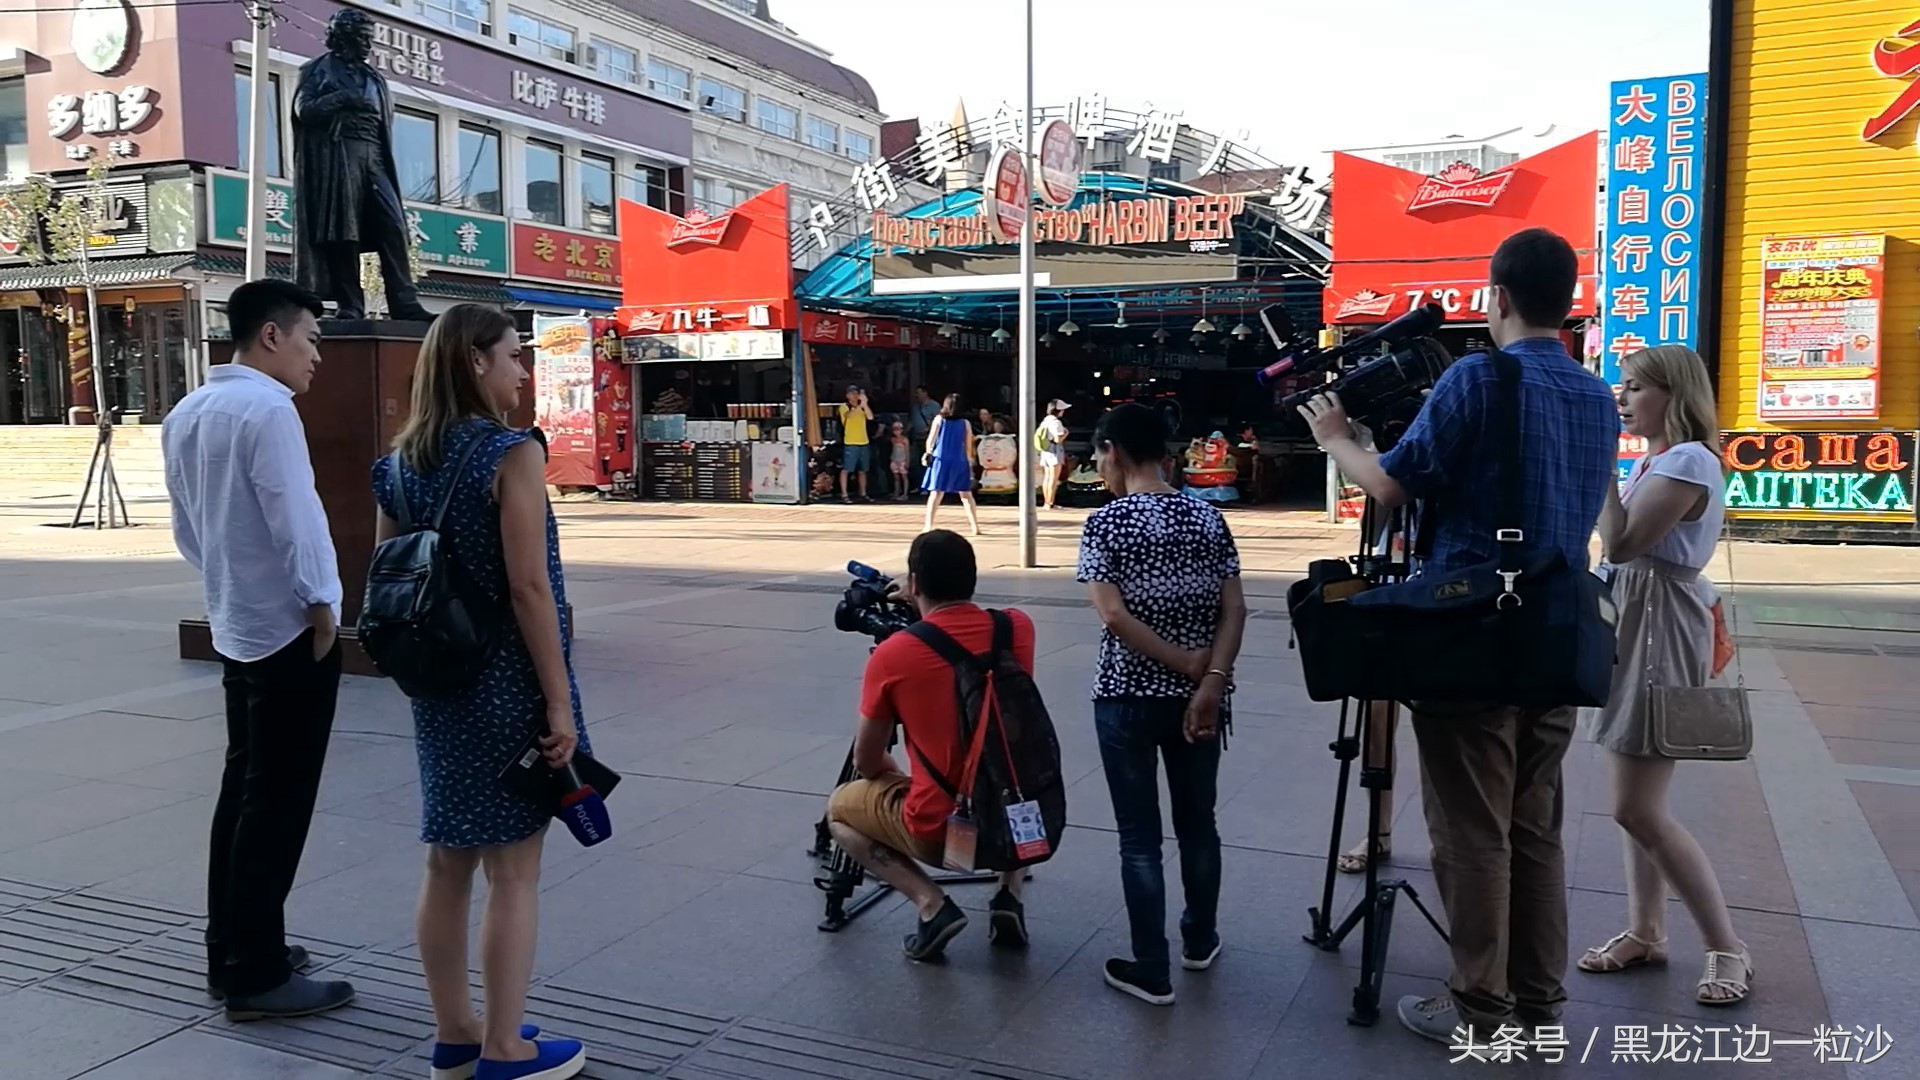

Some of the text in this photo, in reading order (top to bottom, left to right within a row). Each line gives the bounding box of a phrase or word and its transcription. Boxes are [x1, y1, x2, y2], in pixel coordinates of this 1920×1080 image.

[372, 22, 444, 61] ицца
[370, 47, 446, 86] тейк
[1418, 184, 1503, 200] Budweiser
[873, 207, 1081, 258] Представитство
[1659, 81, 1698, 345] ВЕЛОСИП
[533, 232, 615, 269] 老北京
[1771, 268, 1873, 288] 周年庆典
[1723, 471, 1919, 510] АПТЕКА
[574, 804, 599, 840] РОССИЯ
